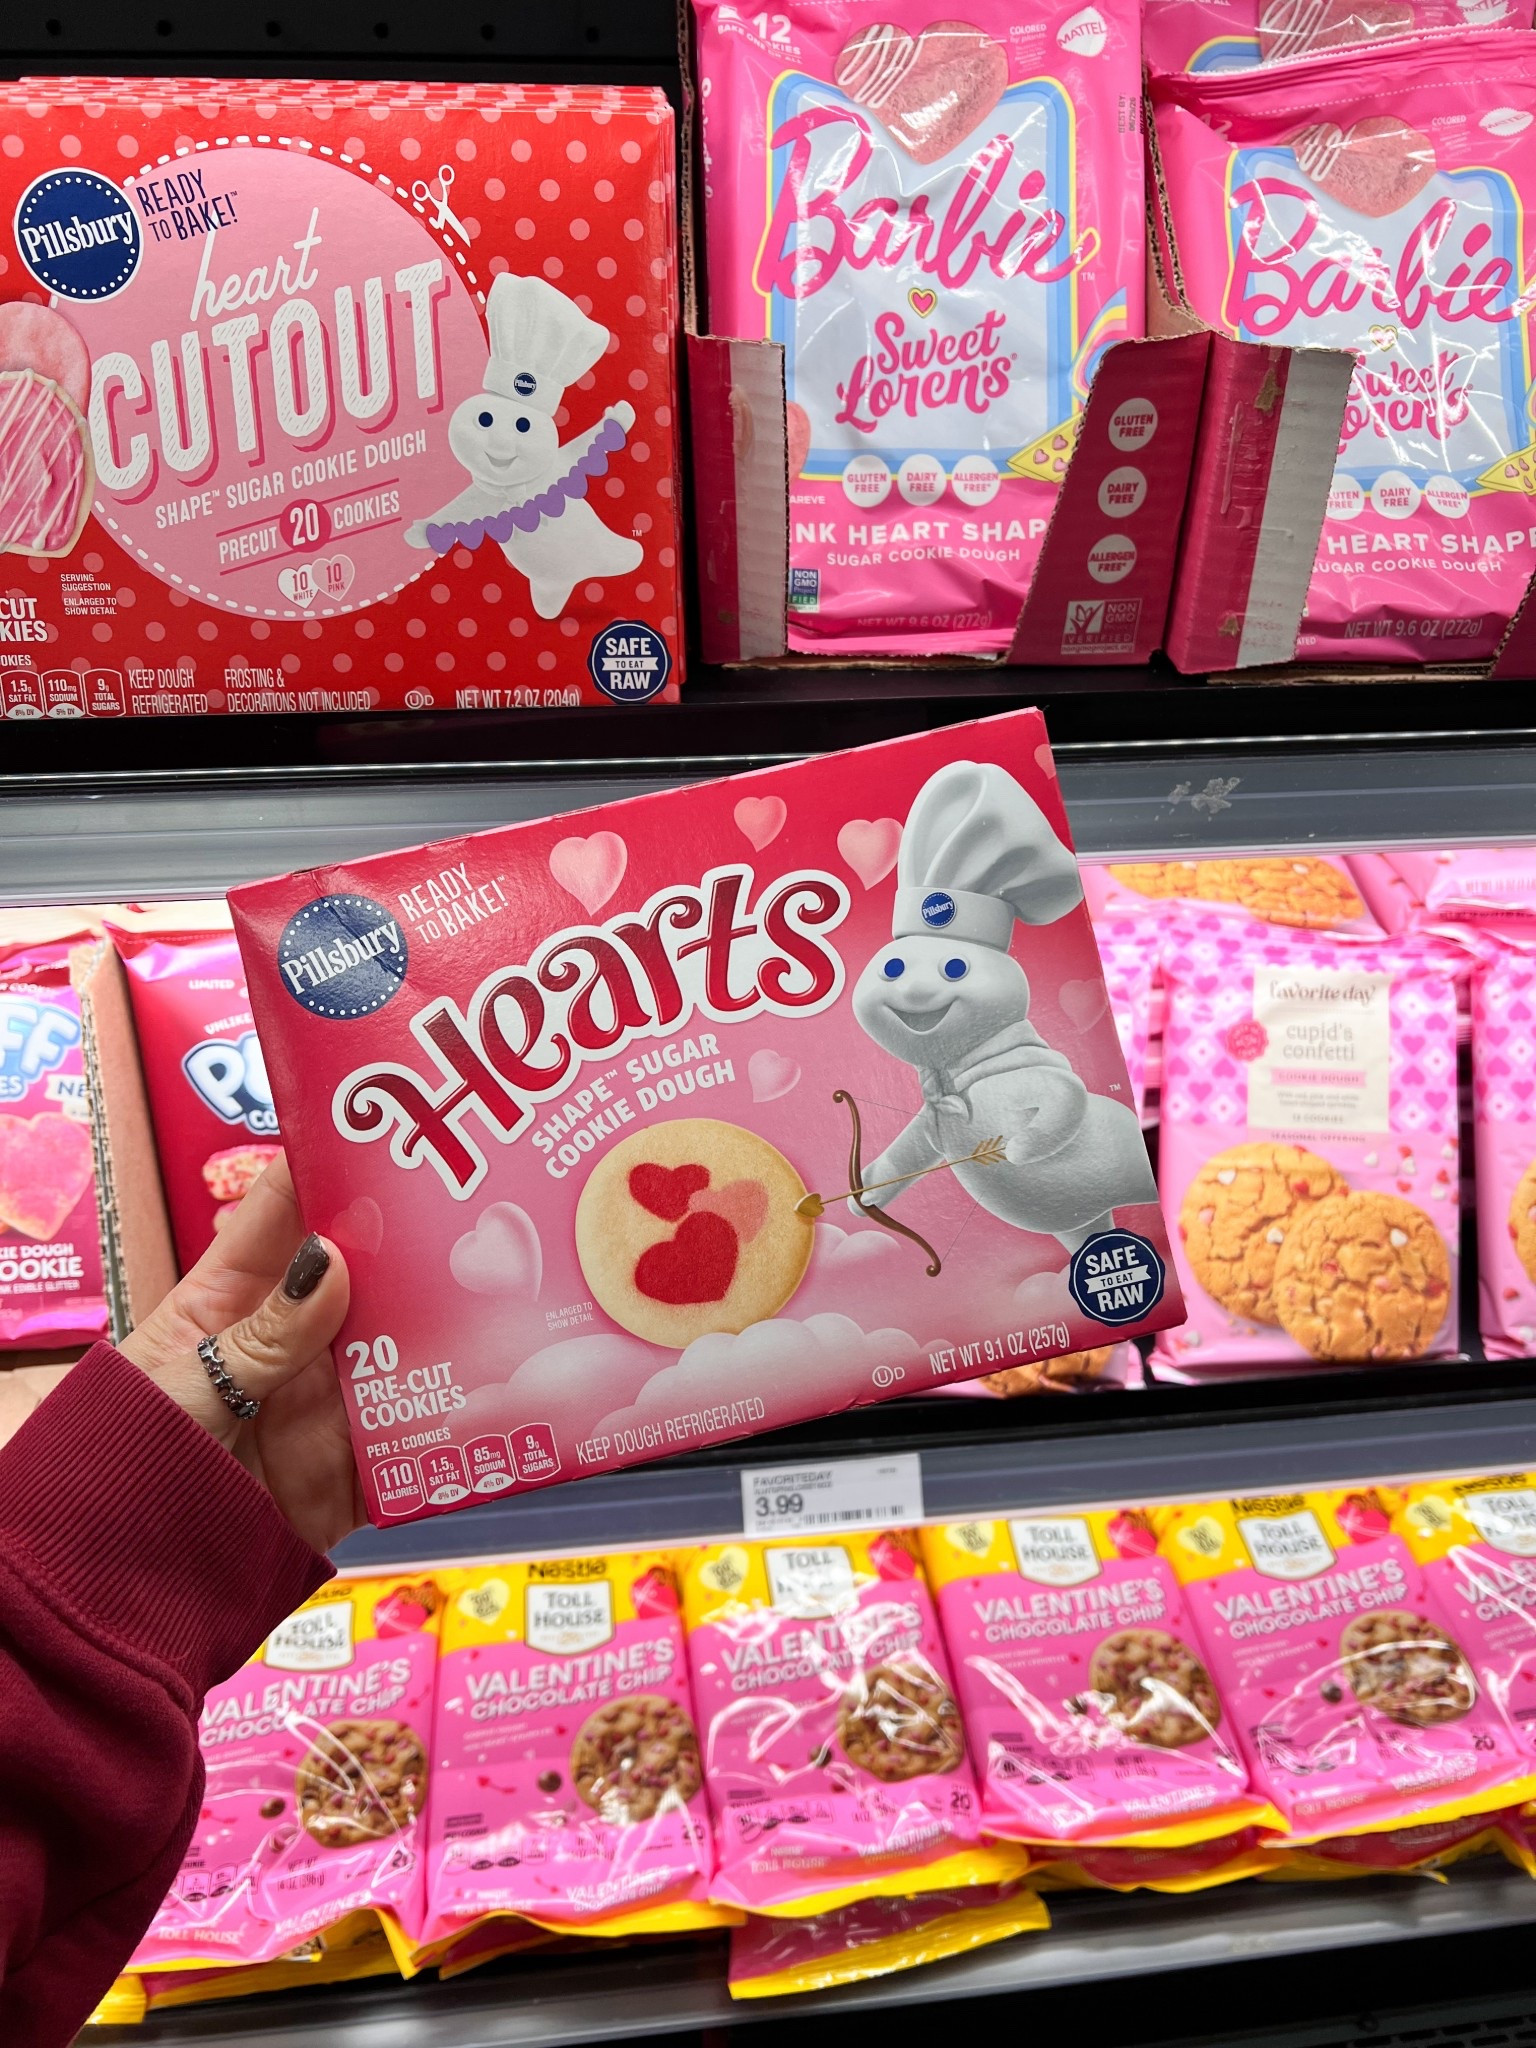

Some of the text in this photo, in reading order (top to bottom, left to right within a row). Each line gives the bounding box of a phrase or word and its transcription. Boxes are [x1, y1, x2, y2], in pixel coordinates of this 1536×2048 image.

[752, 12, 792, 44] 12
[1009, 23, 1047, 35] COLORED
[1059, 21, 1107, 46] MATTEL
[136, 168, 209, 217] READY
[757, 105, 1098, 300] Barbie
[21, 211, 135, 263] Pillsbury
[148, 218, 173, 242] TO
[190, 207, 322, 321] heart
[1225, 177, 1525, 337] Barbie
[874, 309, 1006, 375] Sweet
[88, 259, 450, 495] CUTOUT
[1113, 413, 1154, 427] GLUTEN
[1118, 424, 1145, 438] FREE
[226, 472, 284, 509] SUGAR
[291, 449, 357, 489] COOKIE
[365, 429, 427, 468] DOUGH
[846, 472, 887, 484] GLUTEN
[906, 471, 937, 483] DAIRY
[953, 471, 999, 482] ALLERGEN
[854, 481, 880, 493] FREE
[909, 481, 935, 493] FREE
[1106, 482, 1139, 496] DAIRY
[1380, 487, 1411, 498] DAIRY
[1427, 489, 1468, 500] ALLERGEN
[1108, 492, 1135, 506] FREE
[1329, 499, 1353, 509] FREE
[1383, 497, 1409, 507] FREE
[218, 489, 401, 564] PRECUT 20 COOKIES
[849, 522, 950, 546] HEART
[1327, 532, 1428, 556] HEART
[826, 546, 1020, 567] SUGAR COOKIE DOUGH
[1088, 551, 1135, 564] ALLERGEN
[1371, 558, 1502, 573] COOKIE DOUGH
[60, 573, 95, 583] SERVING
[292, 571, 309, 592] 10
[326, 562, 342, 584] 10
[794, 569, 817, 579] NON
[61, 582, 112, 592] SUGGESTION
[327, 582, 346, 592] PINK
[794, 579, 817, 588] GMO
[63, 597, 117, 606] ENLARGED TO
[292, 589, 314, 601] WHITE
[64, 606, 117, 616] SHOW DETAIL
[1107, 602, 1137, 613] NON
[1105, 613, 1135, 623] GMO
[1068, 633, 1131, 644] VERIFIED
[1344, 619, 1482, 639] NET WT 9.6 OZ (272g)
[605, 637, 652, 656] SAFE
[615, 660, 644, 669] TO EAT
[129, 668, 195, 689] KEEP DOUGH
[225, 668, 285, 689] FROSTING &
[609, 671, 650, 690] RAW
[49, 693, 78, 702] SODIUM
[92, 702, 121, 711] SUGARS
[94, 692, 116, 701] TOTAL
[132, 693, 208, 715] REFRIGERATED
[227, 691, 371, 713] DECORATIONS NOT INCLUDED
[455, 690, 479, 709] NET
[481, 689, 501, 708] WT
[504, 689, 522, 708] 7.2
[524, 689, 541, 707] OZ
[543, 688, 581, 708] (204g)
[397, 862, 473, 922] READY
[922, 899, 954, 919] Pillsbury
[414, 920, 442, 944] TO
[281, 920, 402, 995] Pillsbury
[188, 979, 235, 991] LIMITED
[1270, 980, 1377, 1008] favorite day
[344, 866, 846, 1192] Hearts
[1286, 1022, 1354, 1043] cupid's
[625, 1033, 720, 1083] SUGAR
[1283, 1041, 1355, 1061] confetti
[545, 1059, 736, 1180] COOKIE DOUGH
[20, 1242, 74, 1259] DOUGH
[1084, 1245, 1141, 1276] SAFE
[1100, 1272, 1134, 1287] TO EAT
[1096, 1283, 1144, 1312] RAW
[545, 1301, 593, 1322] ENLARGED TO
[547, 1312, 594, 1331] SHOW DETAIL
[345, 1334, 399, 1380] 20
[928, 1320, 1071, 1376] NET WT 9.1 OZ (257g)
[353, 1361, 454, 1408] PRE-CUT
[359, 1385, 467, 1431] COOKIES
[575, 1395, 766, 1465] KEEP DOUGH REFRIGERATED
[366, 1426, 451, 1459] PER 2 COOKIES
[522, 1458, 554, 1474] SUGARS
[523, 1450, 548, 1462] TOTAL
[380, 1462, 414, 1489] 110
[474, 1460, 506, 1474] SODIUM
[429, 1470, 460, 1486] SAT FAT
[381, 1484, 420, 1502] CALORIES
[755, 1494, 804, 1517] 3.99
[1025, 1525, 1076, 1544] TOLL
[1257, 1519, 1310, 1539] TOLL
[1021, 1543, 1090, 1563] HOUSE
[1253, 1536, 1324, 1558] HOUSE
[782, 1551, 833, 1570] TOLL
[546, 1591, 595, 1608] TOLL
[1213, 1558, 1405, 1622] VALENTINE'S
[973, 1577, 1166, 1624] VALENTINE'S
[534, 1609, 606, 1628] HOUSE
[1229, 1584, 1409, 1640] CHOCOLATE CHIP
[292, 1613, 337, 1637] TOLL
[984, 1601, 1166, 1644] CHOCOLATE CHIP
[274, 1630, 348, 1650] HOUSE
[872, 1631, 923, 1659] CHIP
[466, 1637, 675, 1700] VALENTINE'S
[202, 1658, 411, 1728] VALENTINE'S
[350, 1685, 406, 1715] CHIP
[470, 1665, 672, 1722] CHOCOLATE CHIP
[950, 1791, 971, 1810] 20
